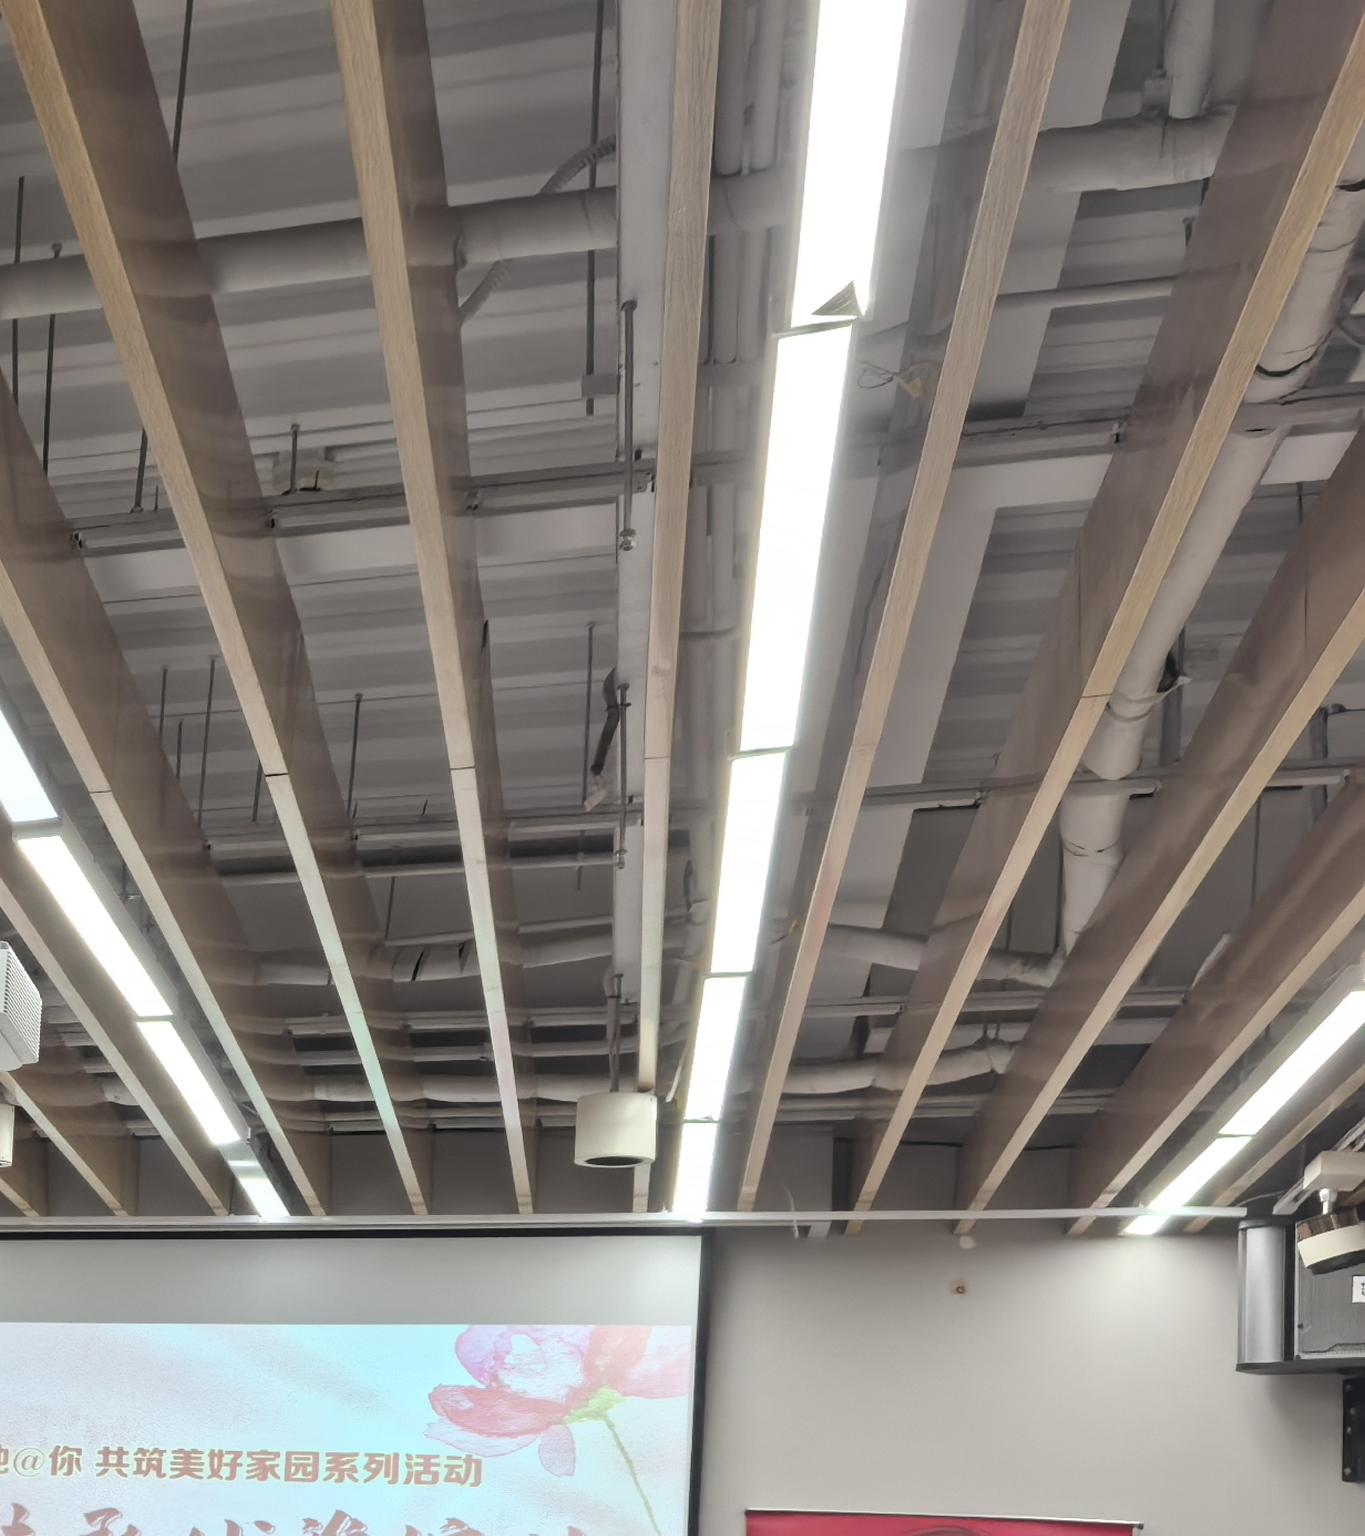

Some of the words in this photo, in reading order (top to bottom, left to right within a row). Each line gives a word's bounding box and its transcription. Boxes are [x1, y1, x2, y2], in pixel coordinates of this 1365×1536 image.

[95, 1446, 483, 1488] 共筑美好家园系列活动
